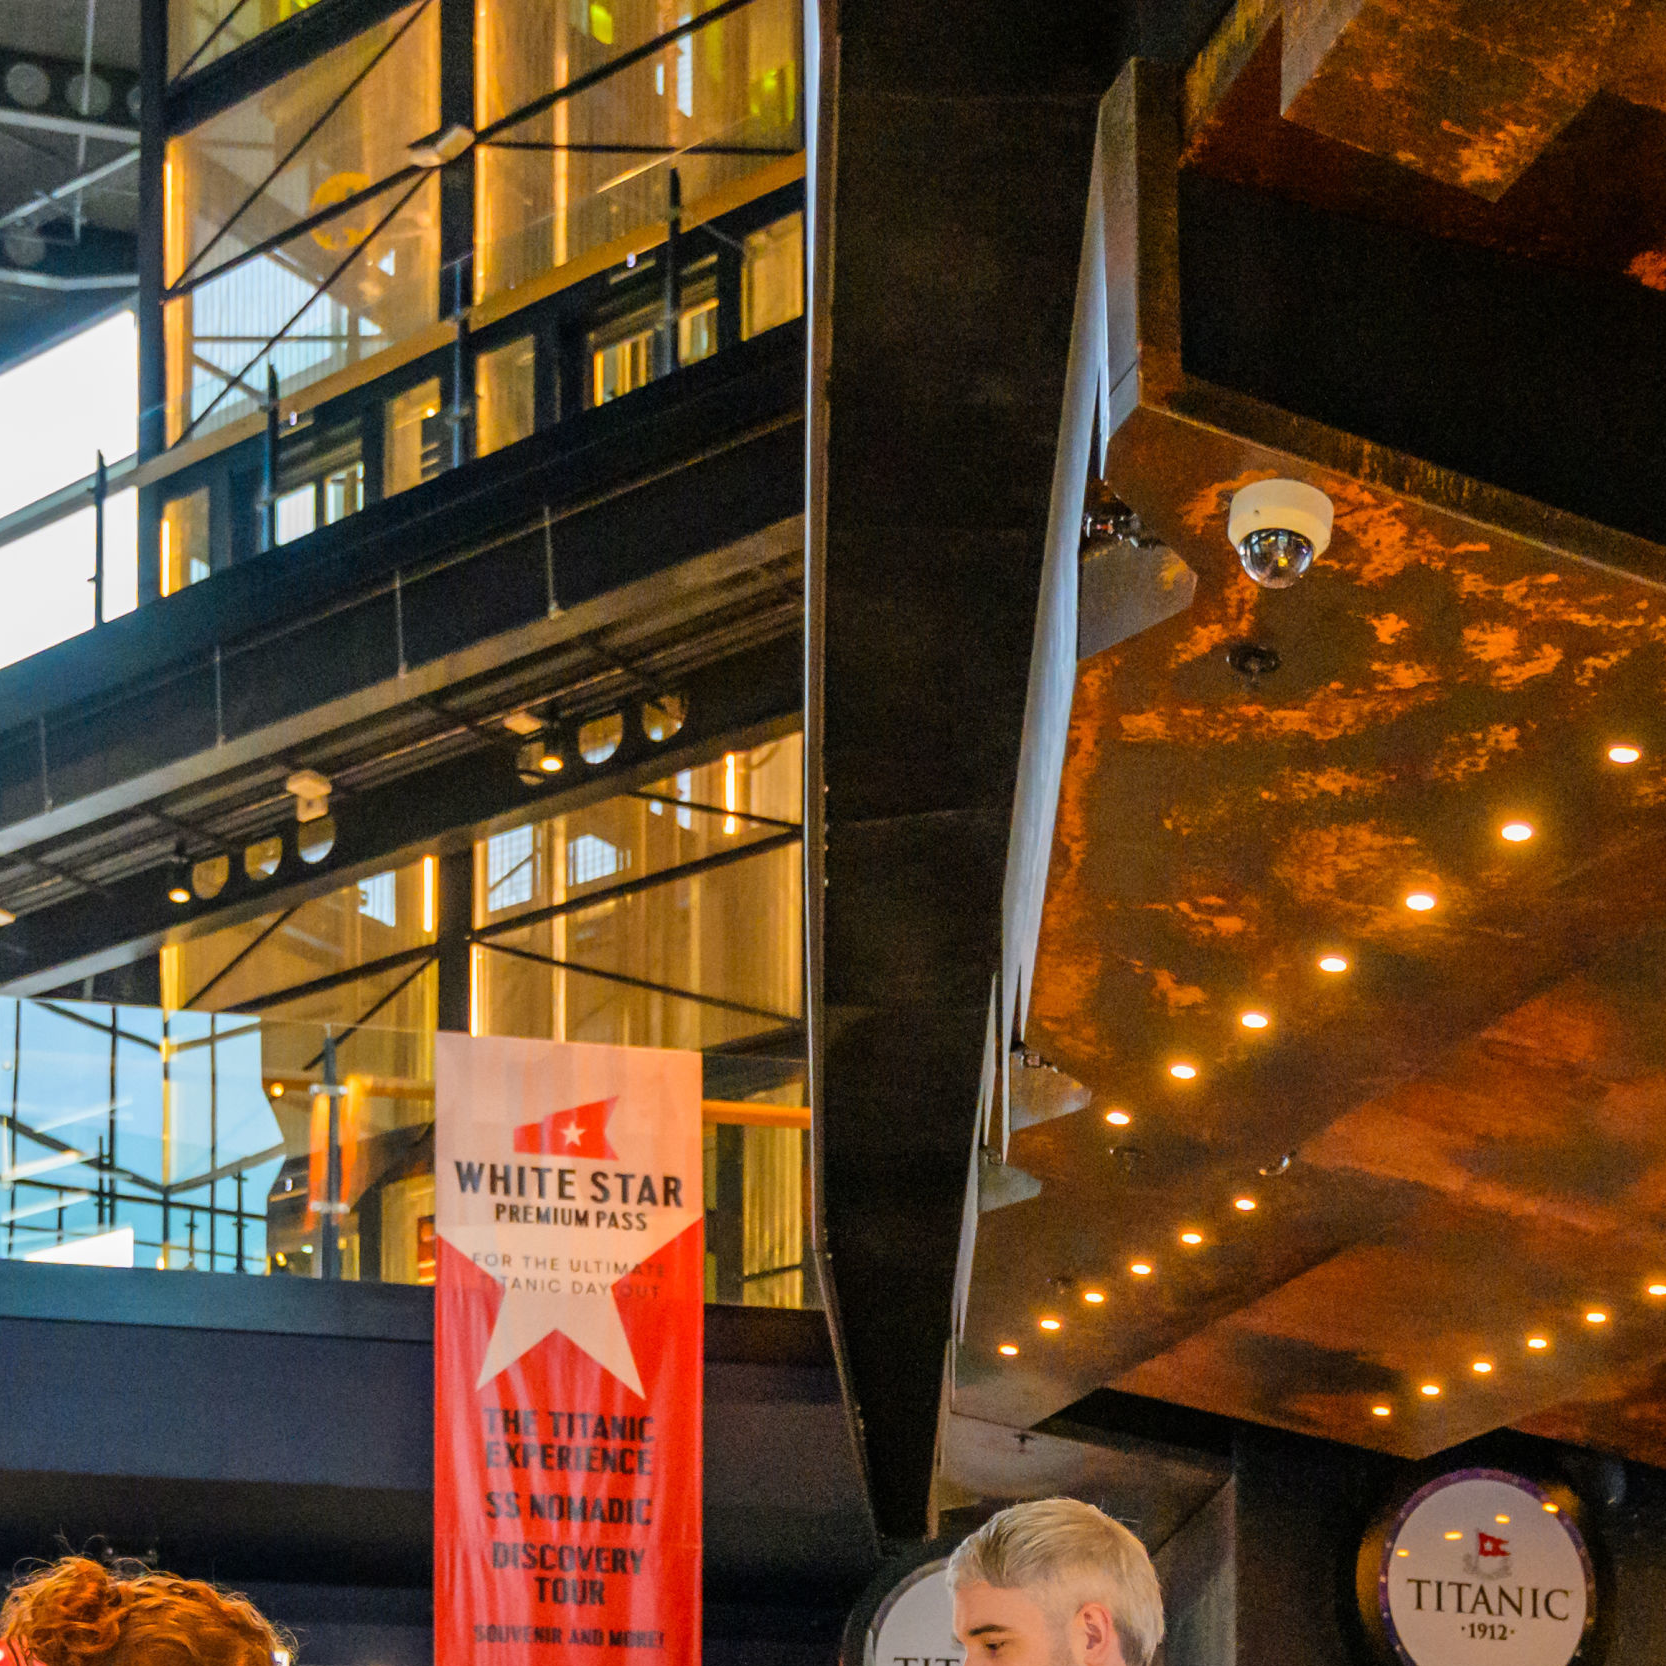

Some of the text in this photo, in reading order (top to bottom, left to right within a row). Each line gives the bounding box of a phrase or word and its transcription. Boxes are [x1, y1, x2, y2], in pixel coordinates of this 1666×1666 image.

[454, 1160, 684, 1208] WHITE STAR
[495, 1203, 648, 1231] PREMIUM PASS
[473, 1252, 665, 1278] FOR THE ULTIMATE
[571, 1280, 610, 1296] DAY
[484, 1407, 655, 1443] THE TITANIC
[486, 1440, 653, 1475] EXPERIENCE
[486, 1491, 652, 1526] SS NOMADIC
[492, 1541, 646, 1576] DISCOVERY
[534, 1576, 606, 1606] TOUR
[1406, 1578, 1573, 1621] TITANIC
[569, 1627, 605, 1647] AND
